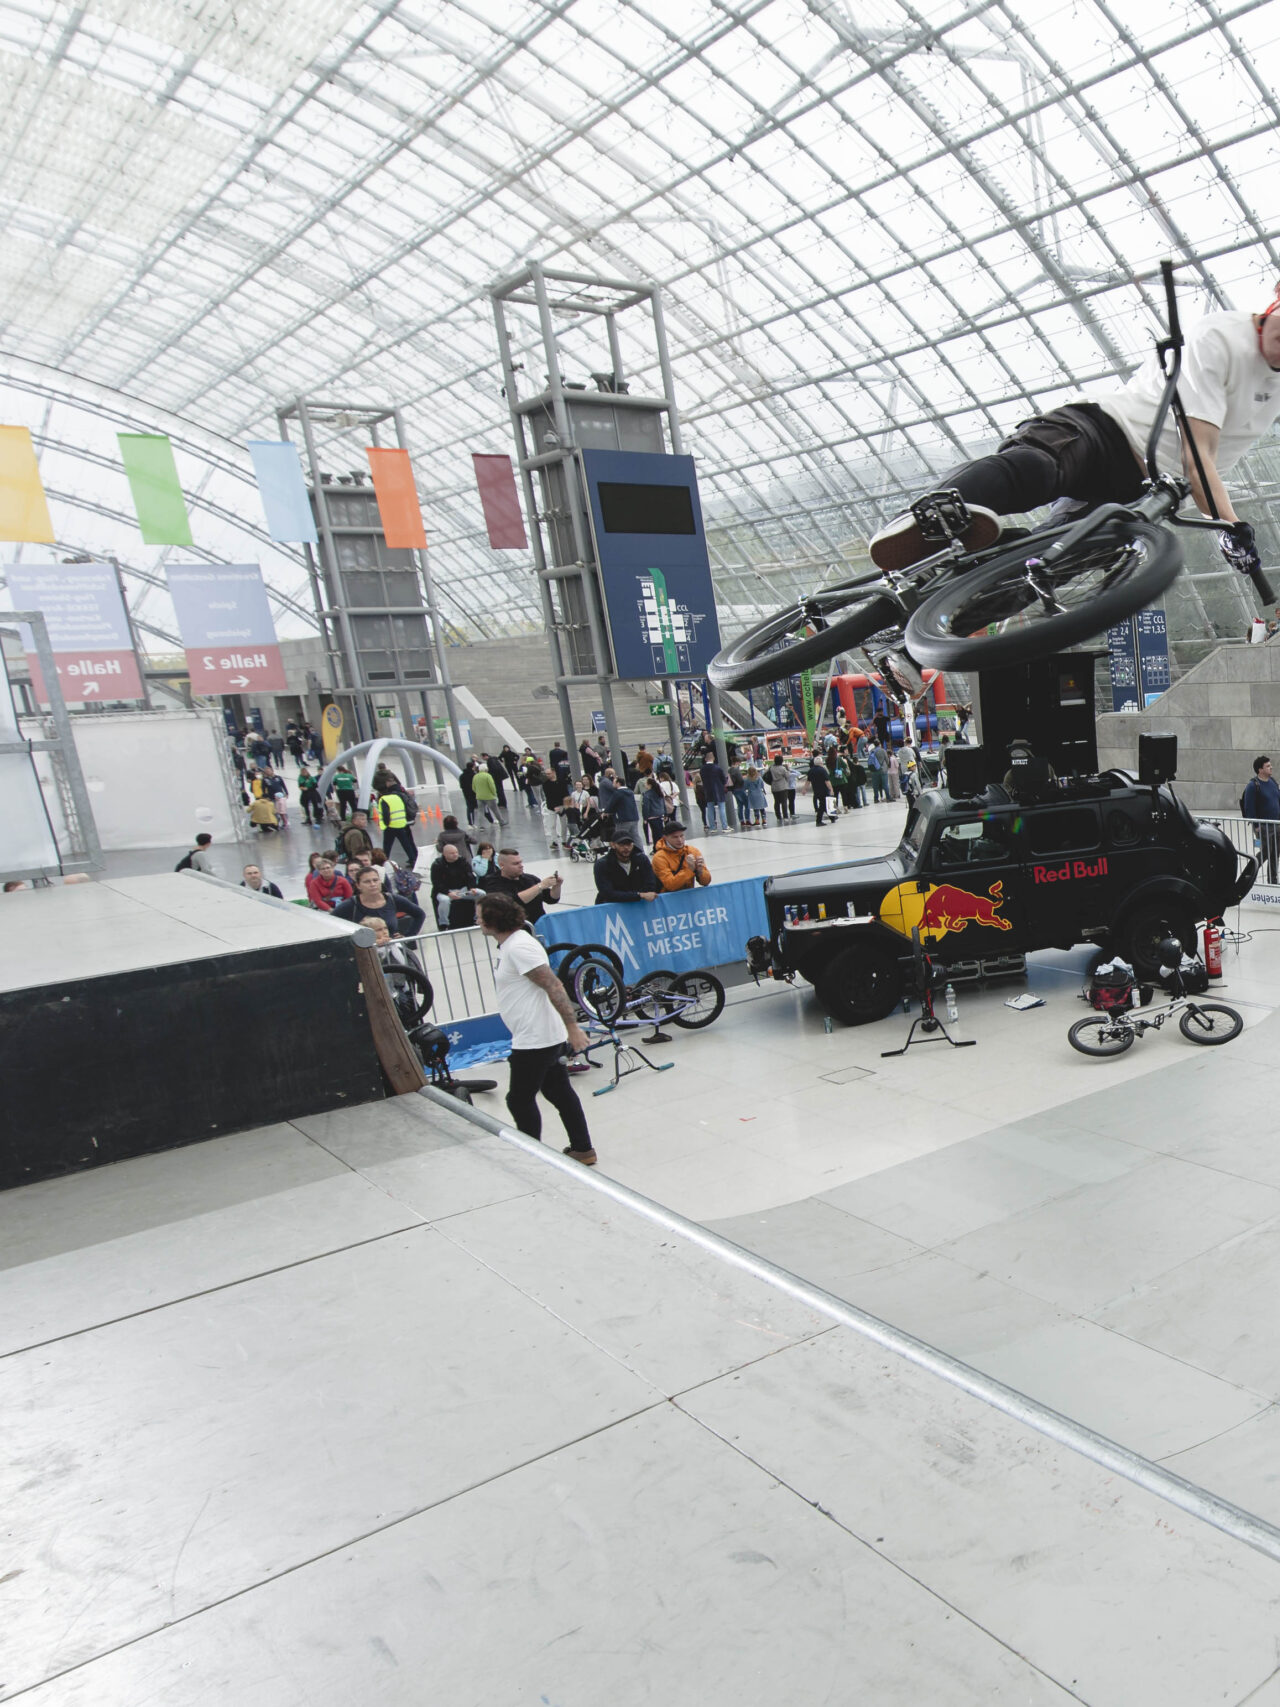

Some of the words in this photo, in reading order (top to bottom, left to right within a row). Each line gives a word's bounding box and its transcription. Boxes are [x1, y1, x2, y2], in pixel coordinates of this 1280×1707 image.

[1153, 616, 1164, 624] CCL
[1033, 862, 1070, 884] Red
[1073, 857, 1109, 879] Bull
[643, 907, 729, 937] LEIPZIGER
[647, 932, 702, 958] MESSE
